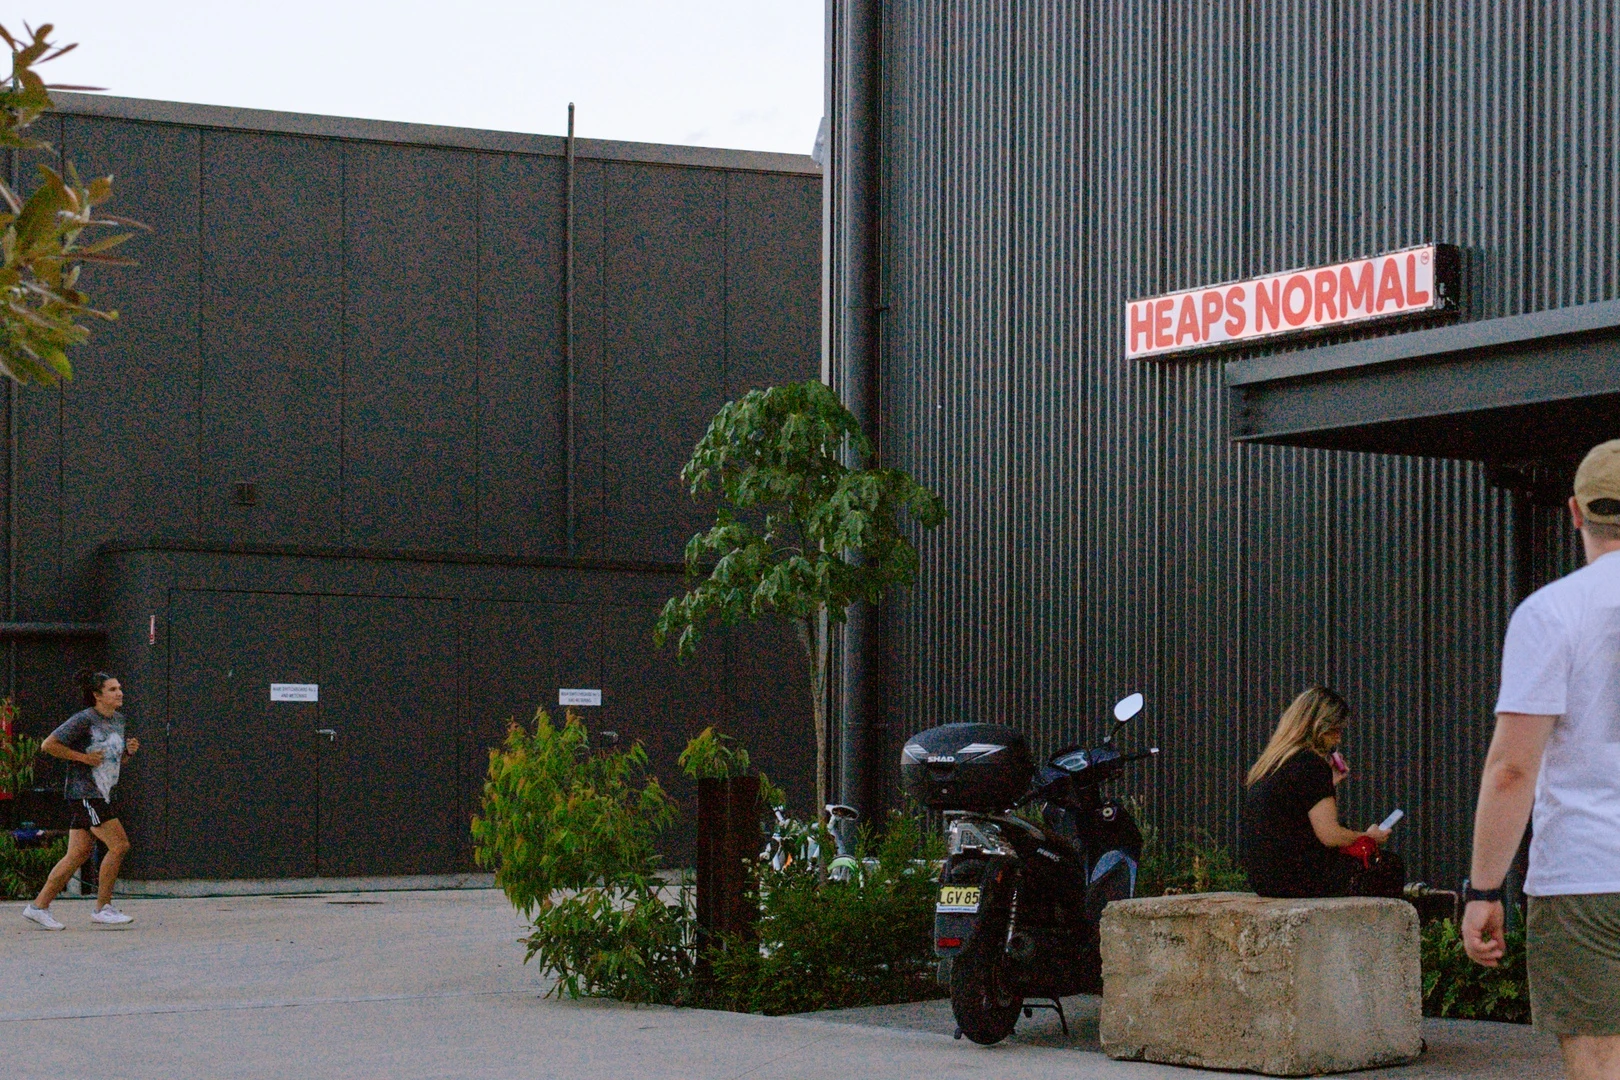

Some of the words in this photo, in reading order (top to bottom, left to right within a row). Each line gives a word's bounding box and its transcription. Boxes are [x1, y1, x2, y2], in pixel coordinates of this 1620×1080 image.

[1130, 285, 1247, 353] HEAPS
[1255, 253, 1430, 332] NORMAL
[927, 755, 955, 763] SHAD
[965, 891, 979, 904] 85
